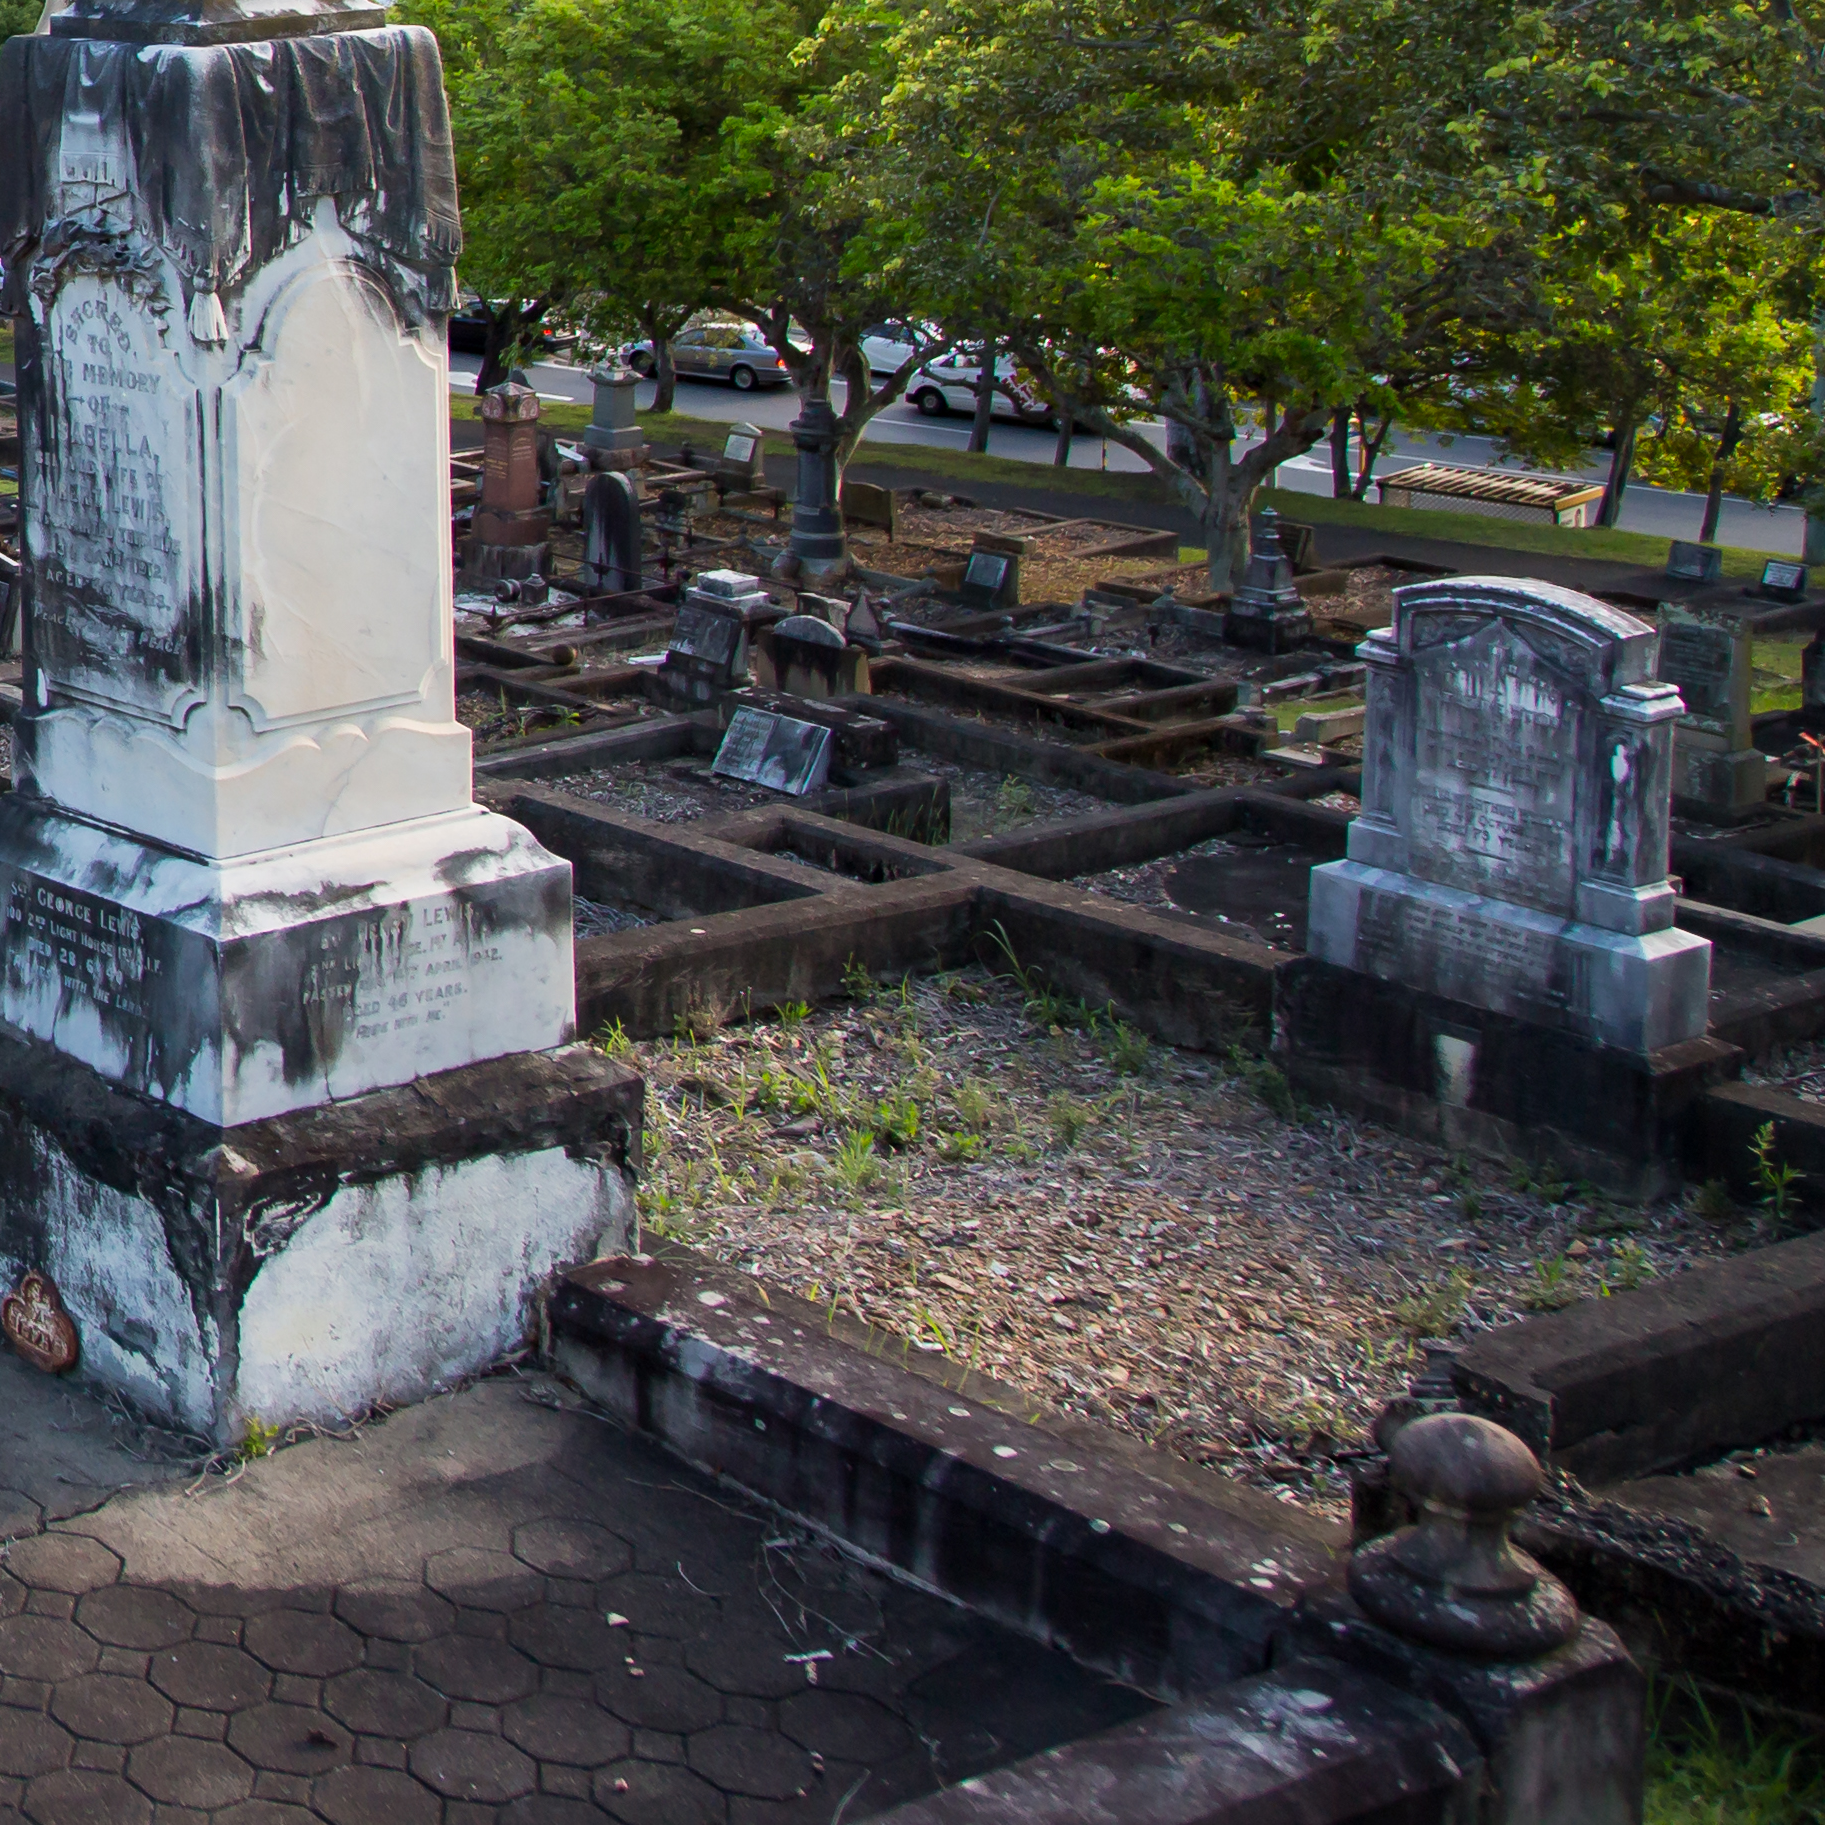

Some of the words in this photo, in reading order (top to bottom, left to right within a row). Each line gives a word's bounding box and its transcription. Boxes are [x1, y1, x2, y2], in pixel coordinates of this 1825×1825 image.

[86, 333, 111, 356] TO
[82, 362, 162, 395] MEMORY
[86, 394, 112, 417] OF
[36, 887, 93, 925] GEORGE
[49, 920, 78, 944] LIGHT
[80, 932, 115, 958] HORSE
[64, 975, 88, 994] WITH
[93, 985, 110, 1004] THE
[415, 981, 468, 1005] YEARS.
